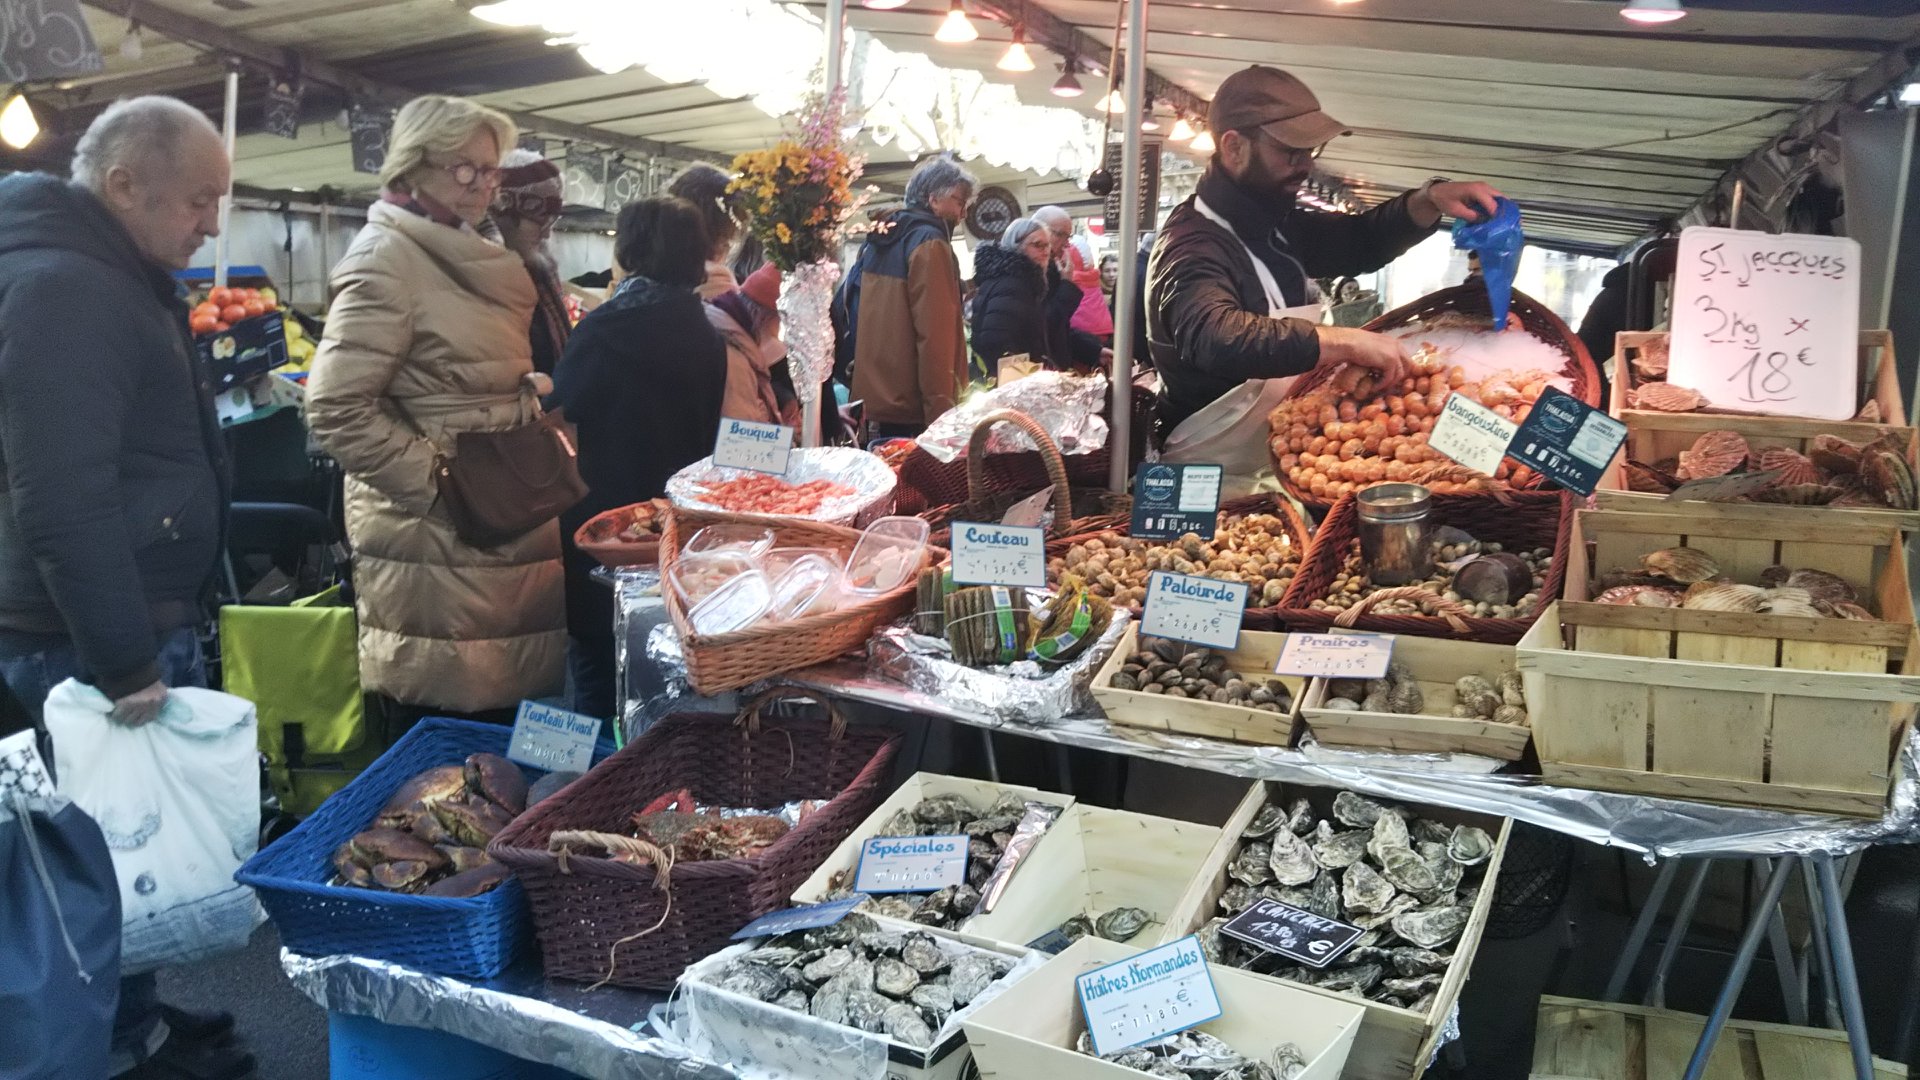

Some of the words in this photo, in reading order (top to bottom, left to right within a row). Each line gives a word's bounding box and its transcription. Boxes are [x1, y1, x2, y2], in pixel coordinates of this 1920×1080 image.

[1727, 351, 1792, 400] 18
[1796, 346, 1817, 366] €
[730, 421, 781, 442] Bouquet
[1145, 478, 1174, 487] THALASSA
[965, 527, 1029, 546] Couteau
[1160, 575, 1235, 602] Palourde
[1300, 635, 1369, 647] Praires
[522, 703, 564, 728] Tourteau
[567, 713, 595, 736] Vivant
[868, 839, 955, 859] Spéciales
[1257, 903, 1336, 932] CANCALE
[1307, 939, 1335, 955] €
[1128, 947, 1198, 985] Normandes
